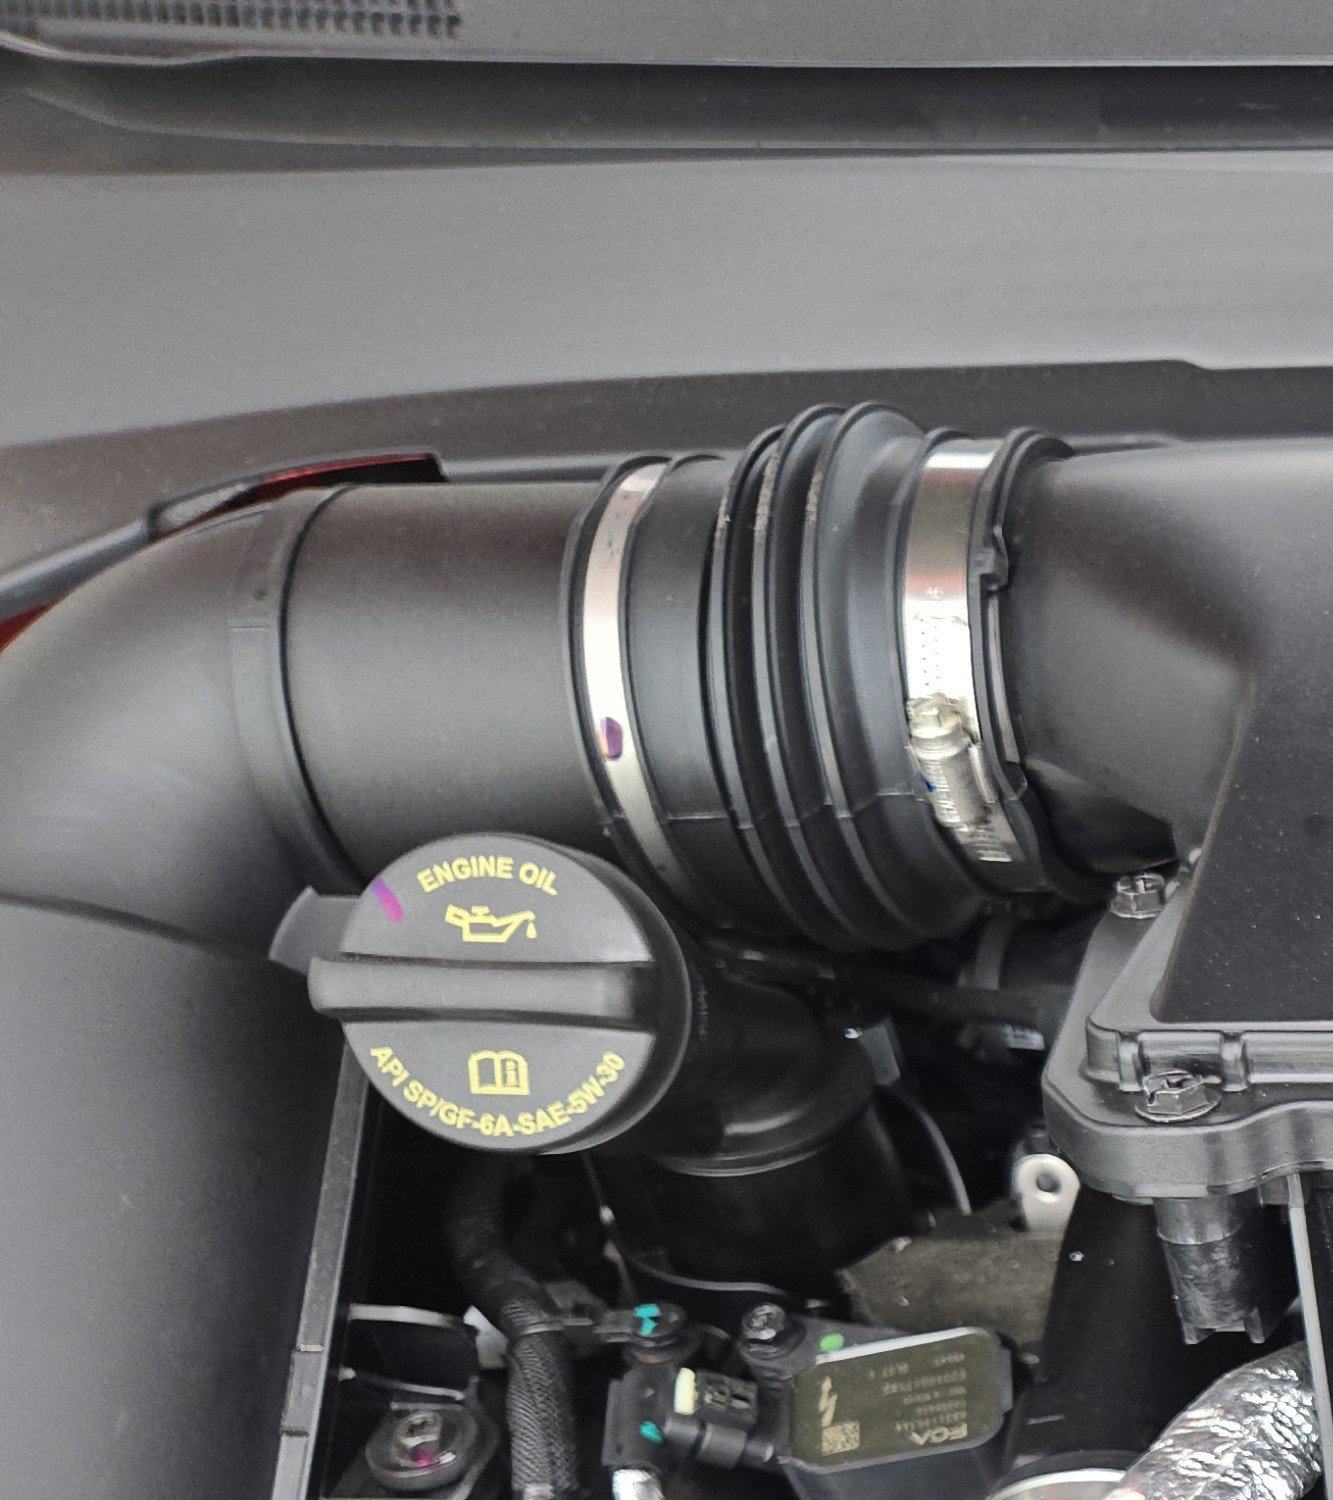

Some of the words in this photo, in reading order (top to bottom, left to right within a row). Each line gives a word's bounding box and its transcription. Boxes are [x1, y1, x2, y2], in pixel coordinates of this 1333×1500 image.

[417, 855, 513, 894] ENGINE
[519, 862, 559, 896] OIL
[370, 1045, 407, 1089] API
